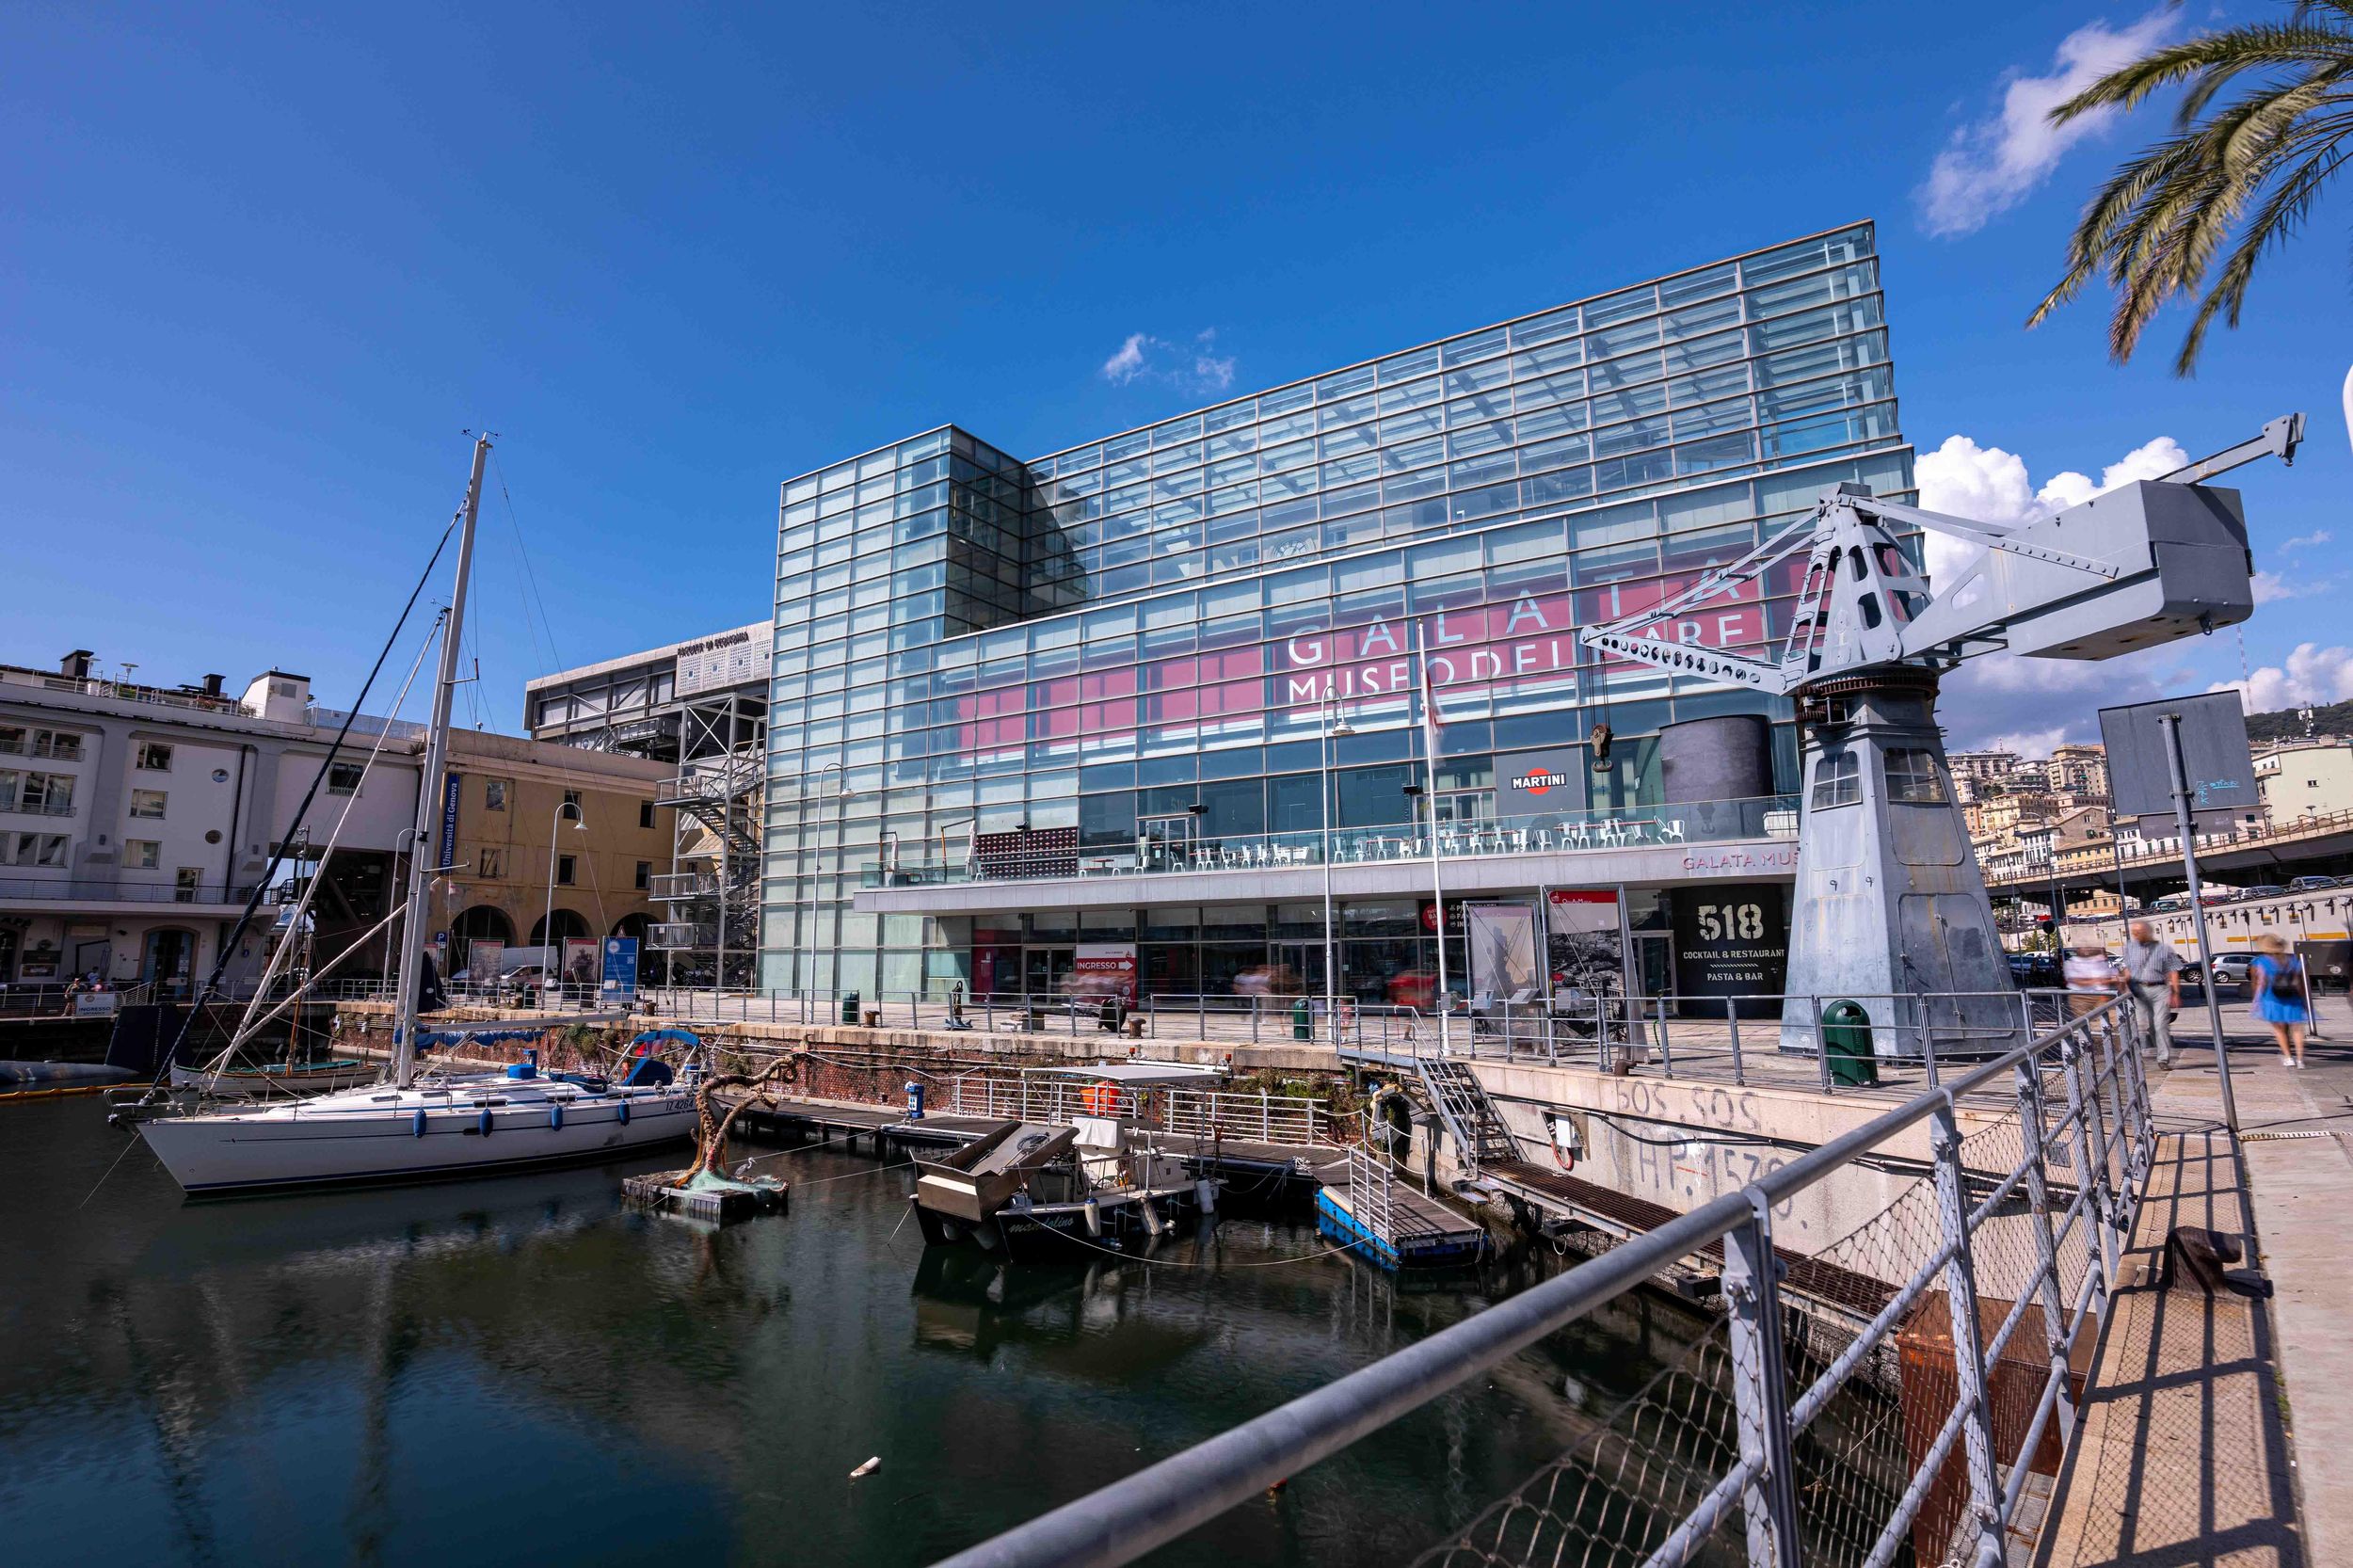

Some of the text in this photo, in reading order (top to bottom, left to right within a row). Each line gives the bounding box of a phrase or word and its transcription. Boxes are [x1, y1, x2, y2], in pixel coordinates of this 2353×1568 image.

[1512, 773, 1566, 789] MARTINI
[442, 782, 457, 866] Università di Genova
[1683, 852, 1756, 871] GALATA
[1697, 904, 1765, 941] 518
[1683, 949, 1785, 960] COCKTAIL & RESTAURANT
[1077, 961, 1117, 969] INGRESSO
[1706, 971, 1764, 981] PASTA & BAR
